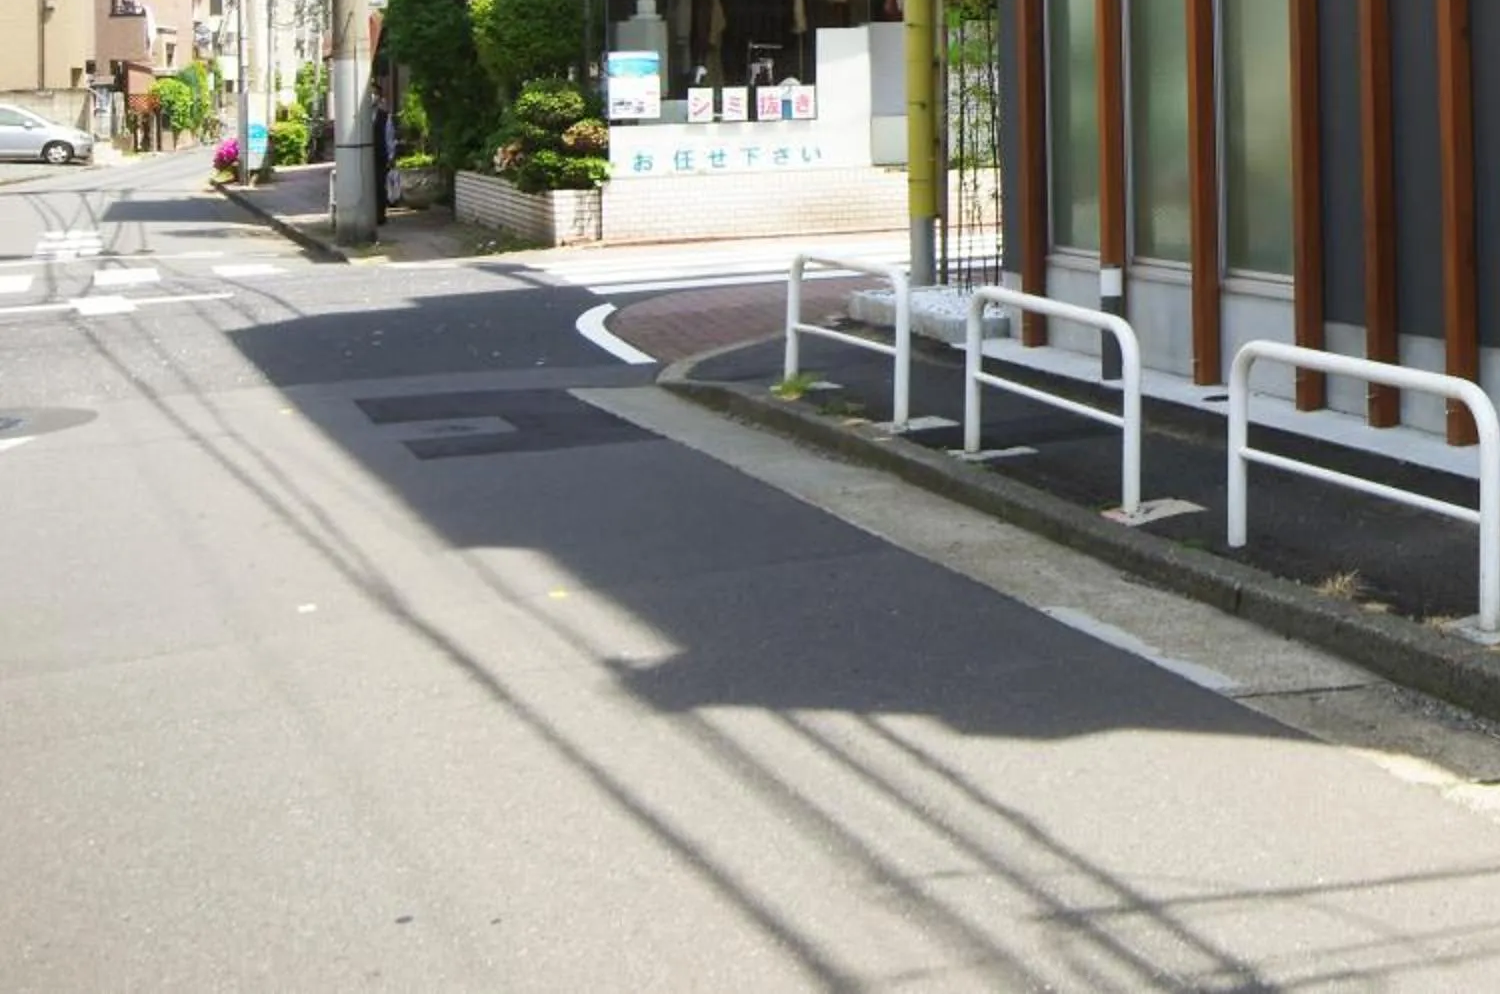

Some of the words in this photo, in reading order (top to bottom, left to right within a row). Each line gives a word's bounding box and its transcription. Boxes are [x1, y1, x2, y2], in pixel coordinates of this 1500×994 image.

[633, 146, 822, 172] お任せ下さい
